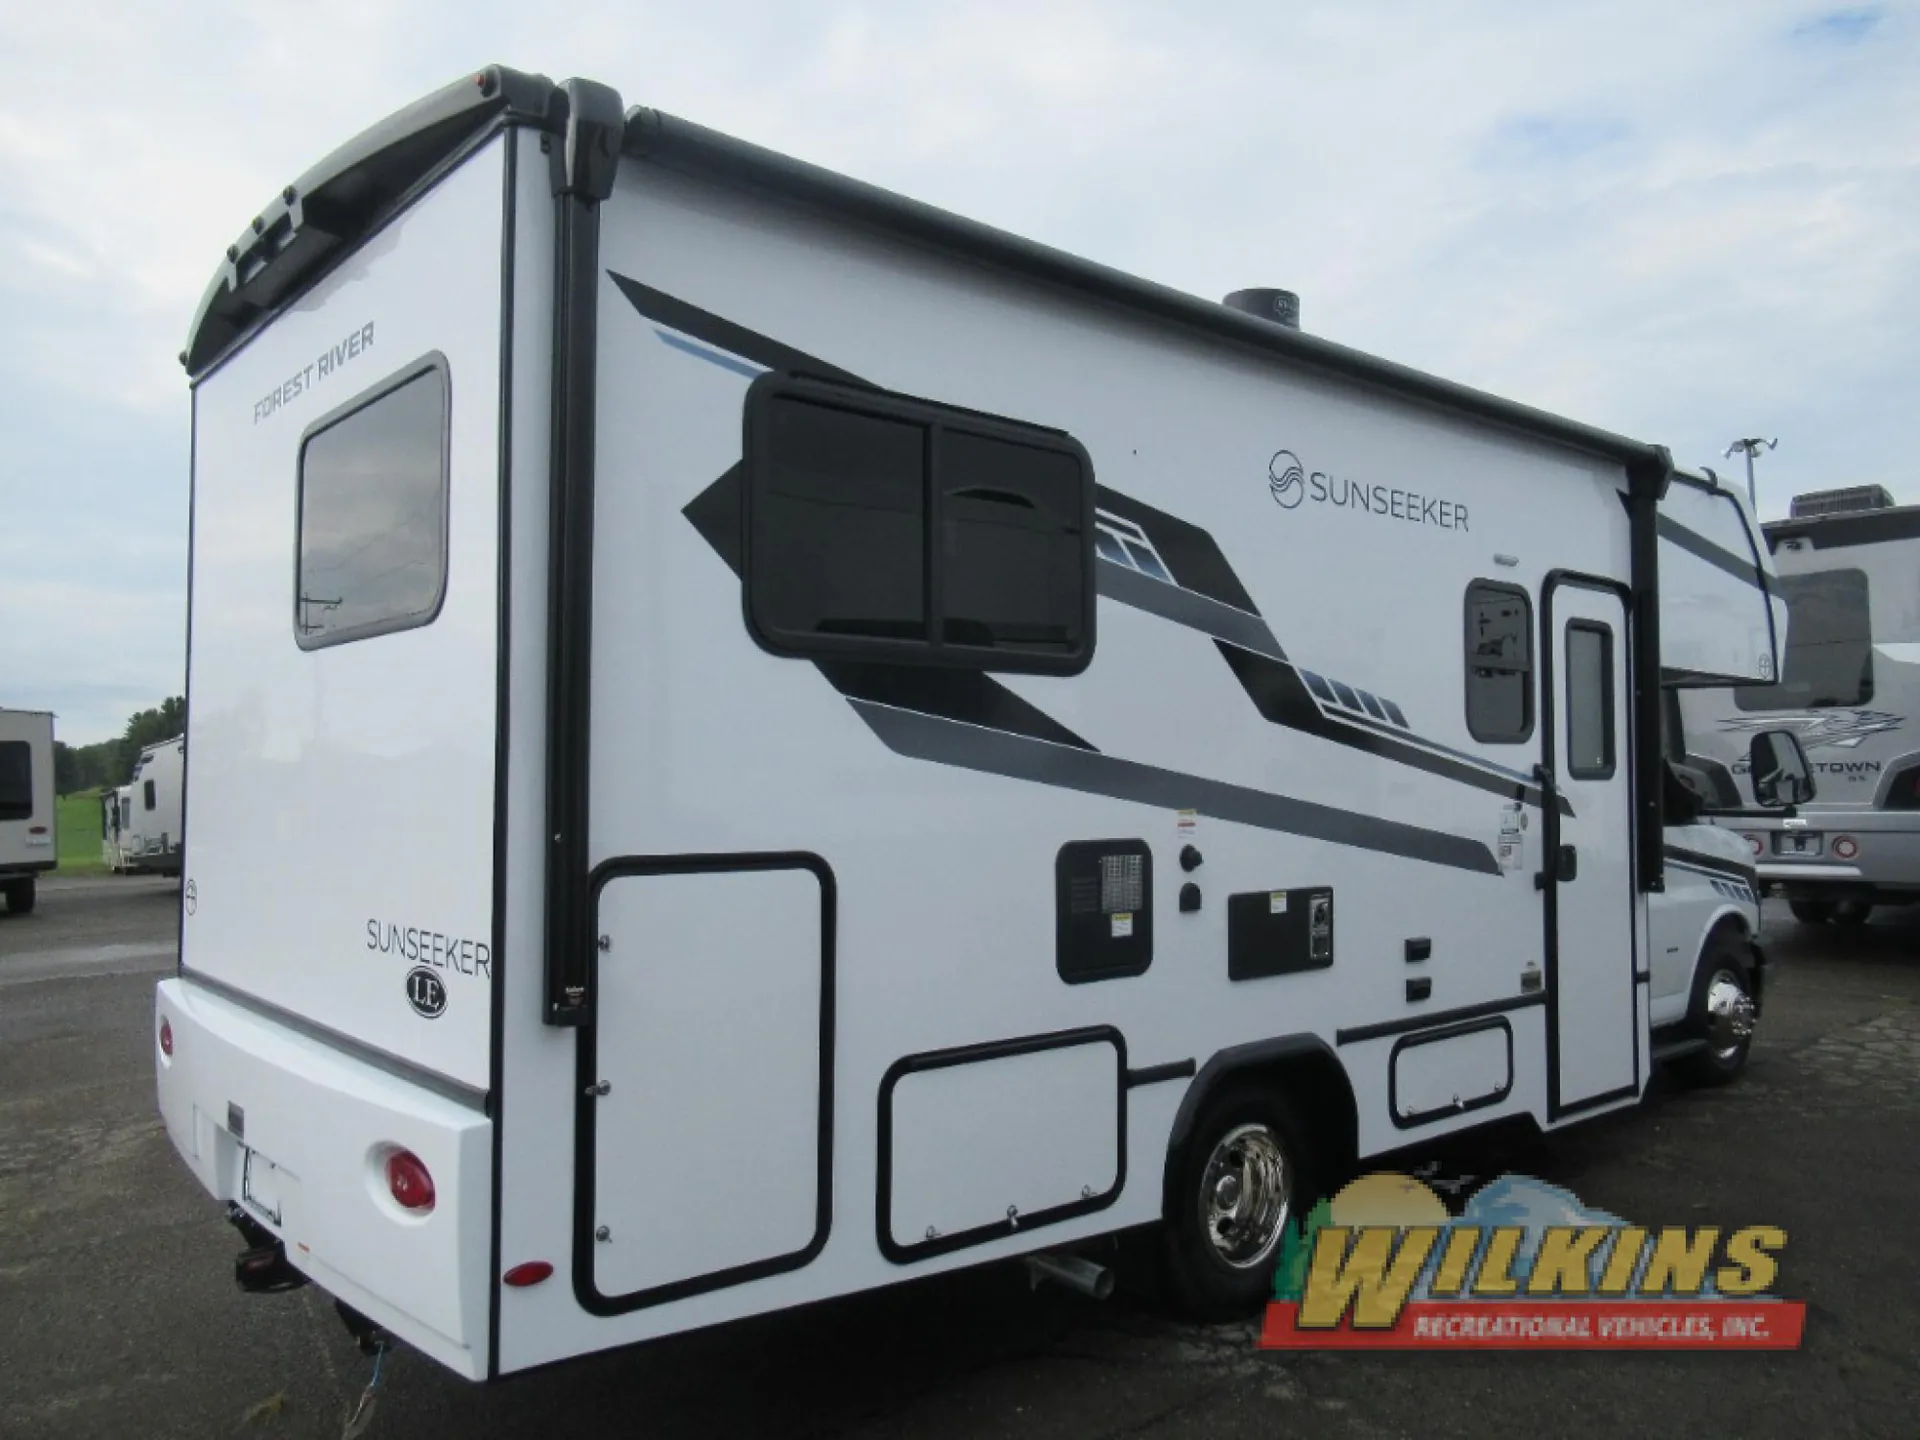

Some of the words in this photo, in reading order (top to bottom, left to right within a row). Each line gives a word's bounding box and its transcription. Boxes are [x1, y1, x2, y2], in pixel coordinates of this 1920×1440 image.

[254, 363, 314, 426] FOREST
[317, 320, 375, 382] RIVER
[1309, 471, 1469, 533] SUNSEEKER
[1731, 761, 1881, 775] GTOWN
[366, 918, 491, 980] SUNSEEKER
[413, 976, 441, 1010] LE
